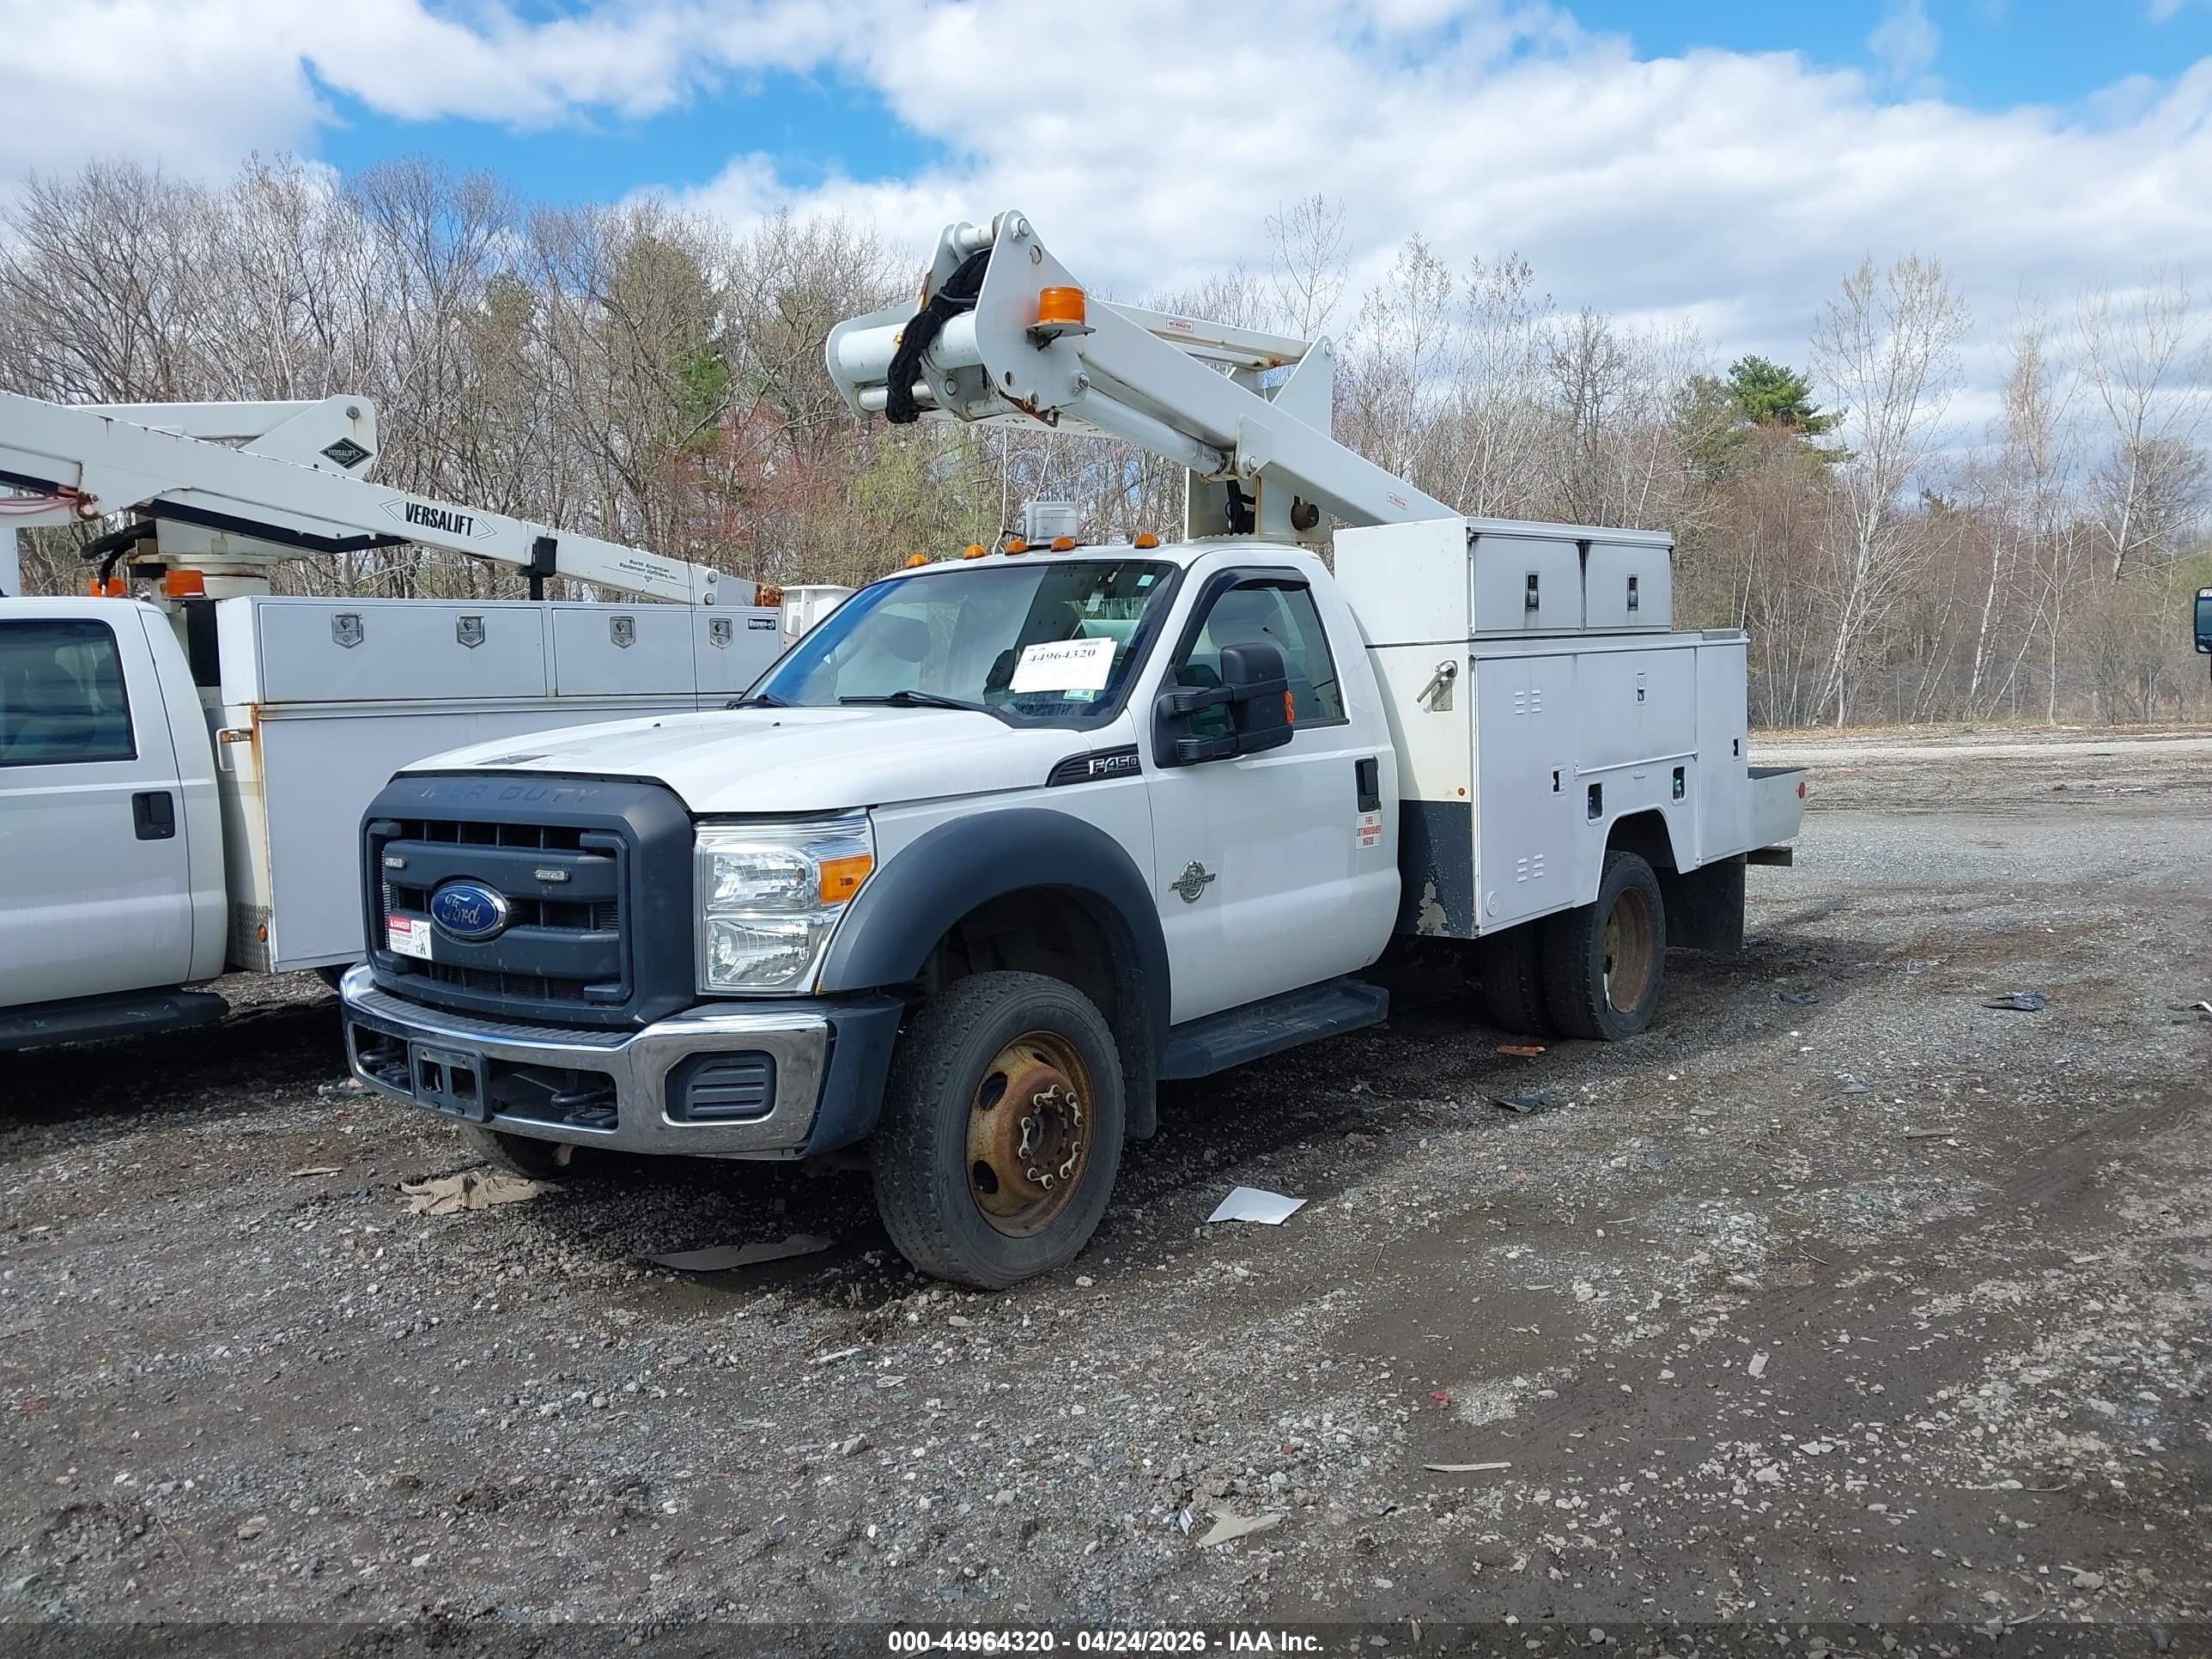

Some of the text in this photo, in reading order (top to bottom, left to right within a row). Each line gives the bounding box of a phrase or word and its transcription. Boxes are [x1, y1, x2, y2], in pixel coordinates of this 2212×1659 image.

[405, 501, 474, 536] VERSALIFT
[619, 562, 646, 572] Equipment
[645, 563, 670, 574] American
[1029, 649, 1097, 662] 44964320
[497, 785, 600, 804] DUTY
[1365, 816, 1374, 824] FIRE
[1357, 824, 1381, 836] EXTINGUISHER
[1363, 836, 1374, 846] INSIDE
[441, 893, 481, 925] Ford
